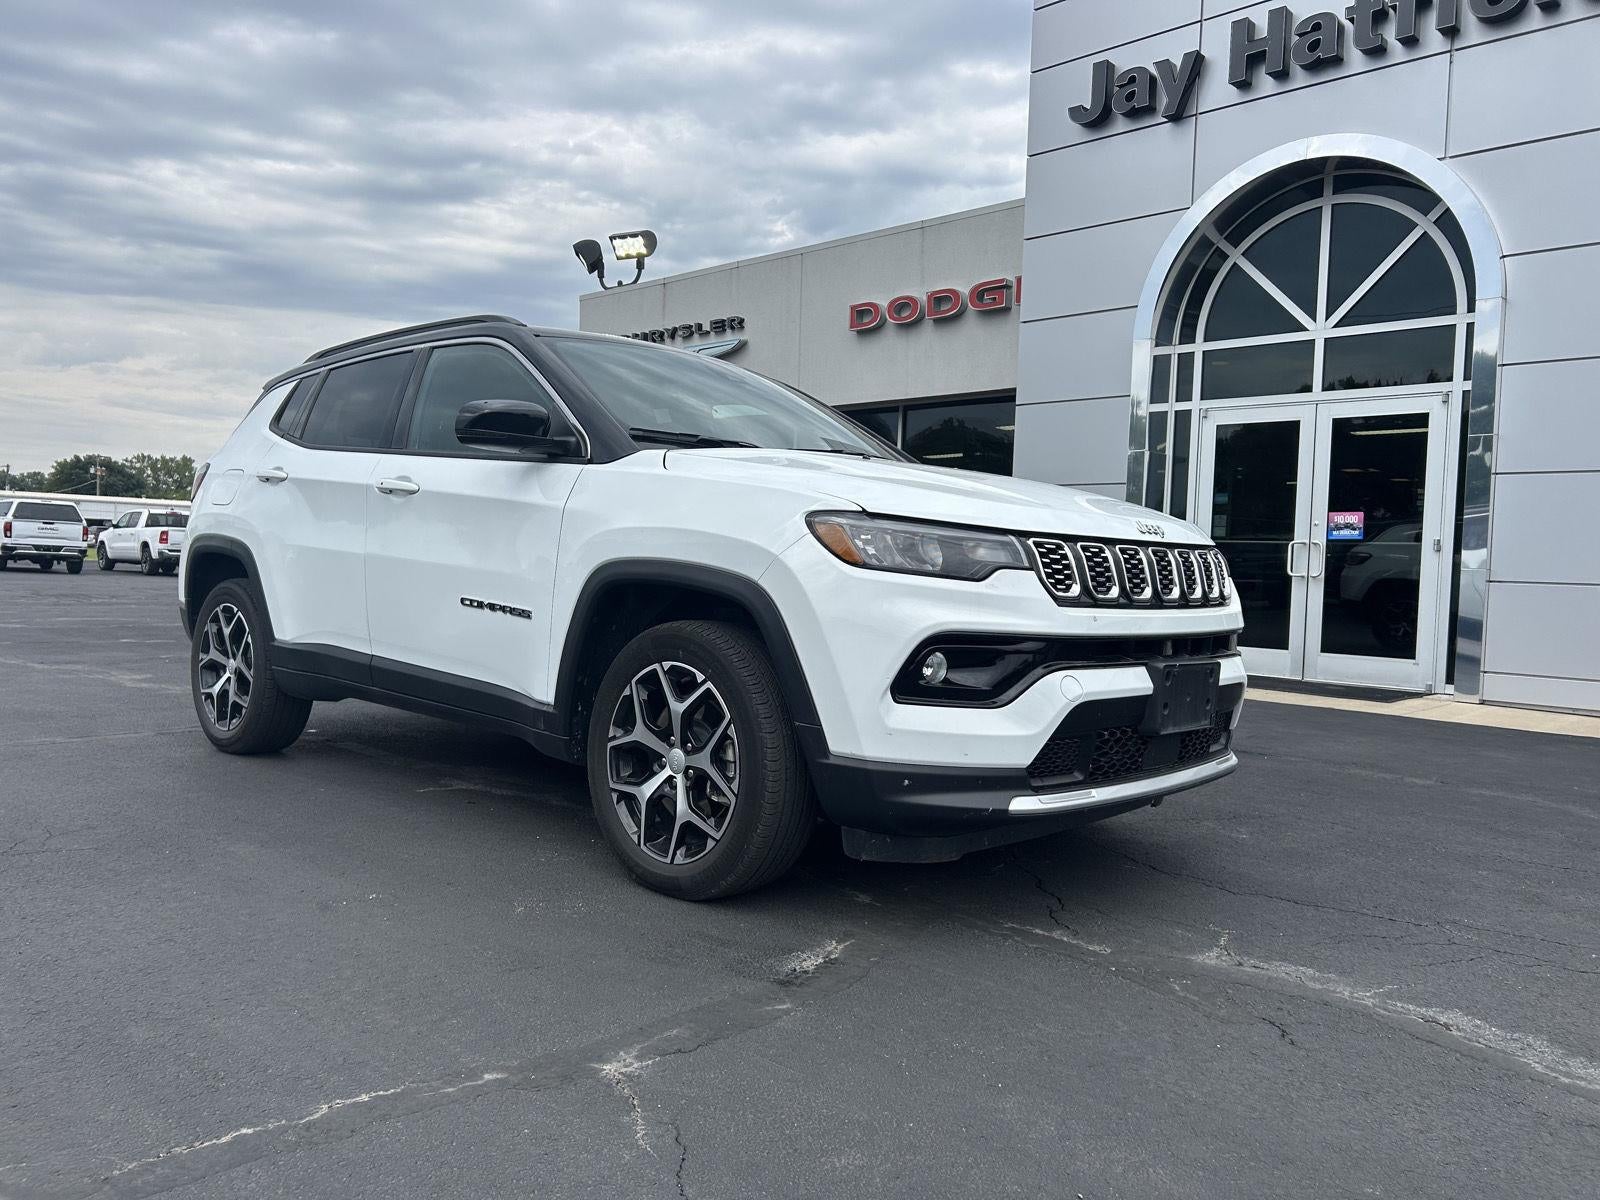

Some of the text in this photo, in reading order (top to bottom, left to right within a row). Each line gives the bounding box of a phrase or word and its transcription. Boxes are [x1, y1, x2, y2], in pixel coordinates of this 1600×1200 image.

[1068, 50, 1204, 127] Jay
[849, 275, 1022, 333] DODG
[621, 316, 746, 343] HRYSLER
[1136, 520, 1164, 538] Jeep
[460, 597, 532, 620] COMPASS
